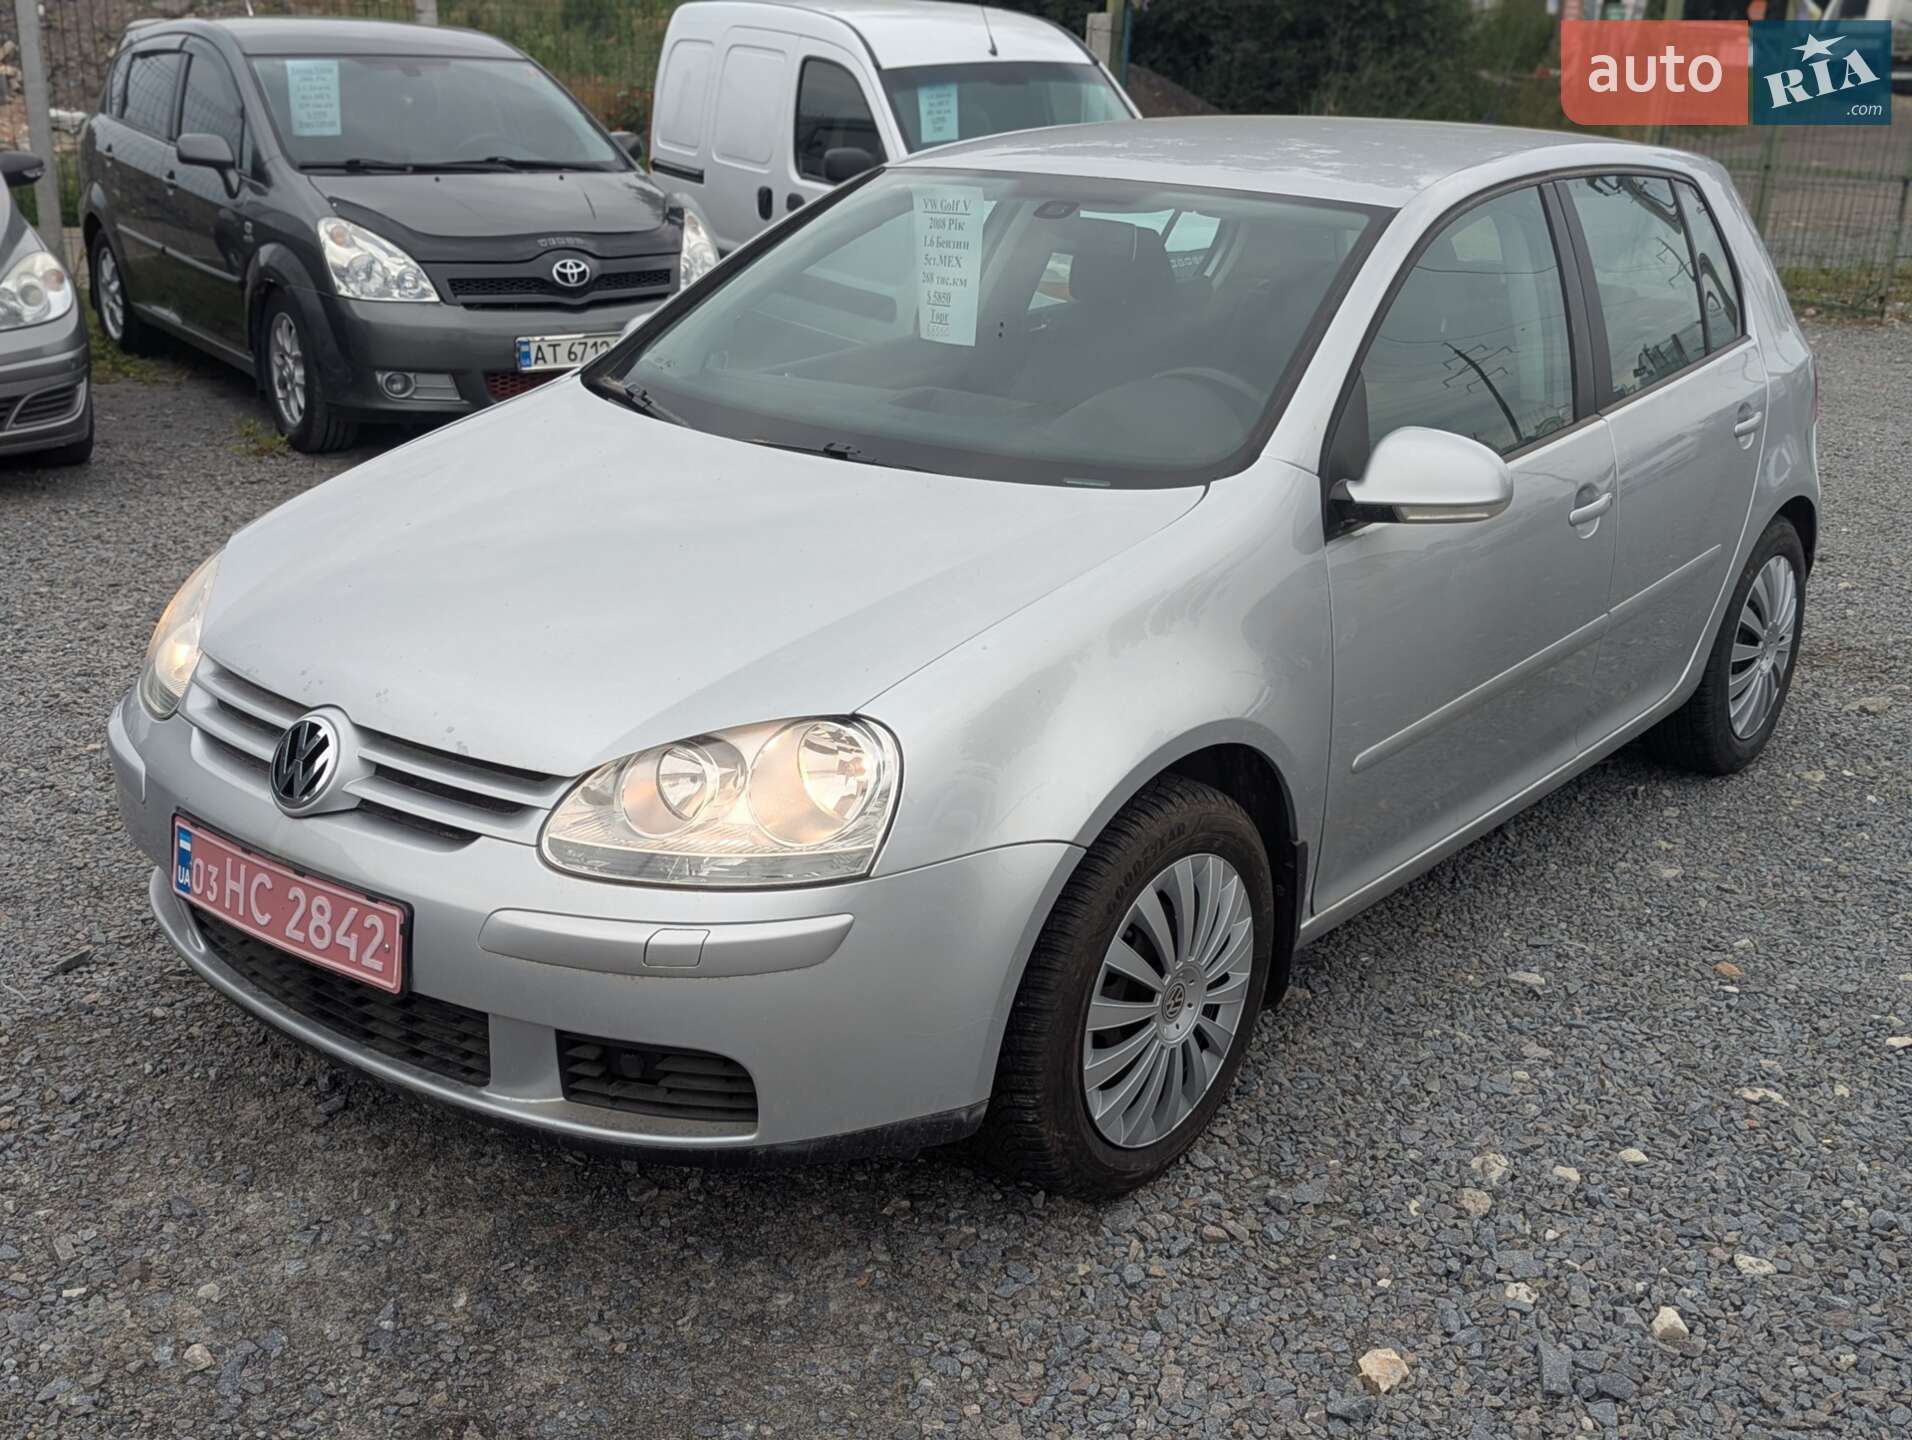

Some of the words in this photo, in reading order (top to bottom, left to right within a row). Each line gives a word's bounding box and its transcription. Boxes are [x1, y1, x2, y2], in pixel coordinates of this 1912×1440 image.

[922, 199, 939, 210] VW
[940, 199, 961, 212] Golf
[962, 199, 972, 212] V
[924, 235, 935, 248] 1.6
[936, 236, 970, 250] Бензин
[534, 344, 562, 365] AT
[177, 866, 191, 888] UA
[225, 857, 273, 926] HC
[285, 887, 385, 972] 2842
